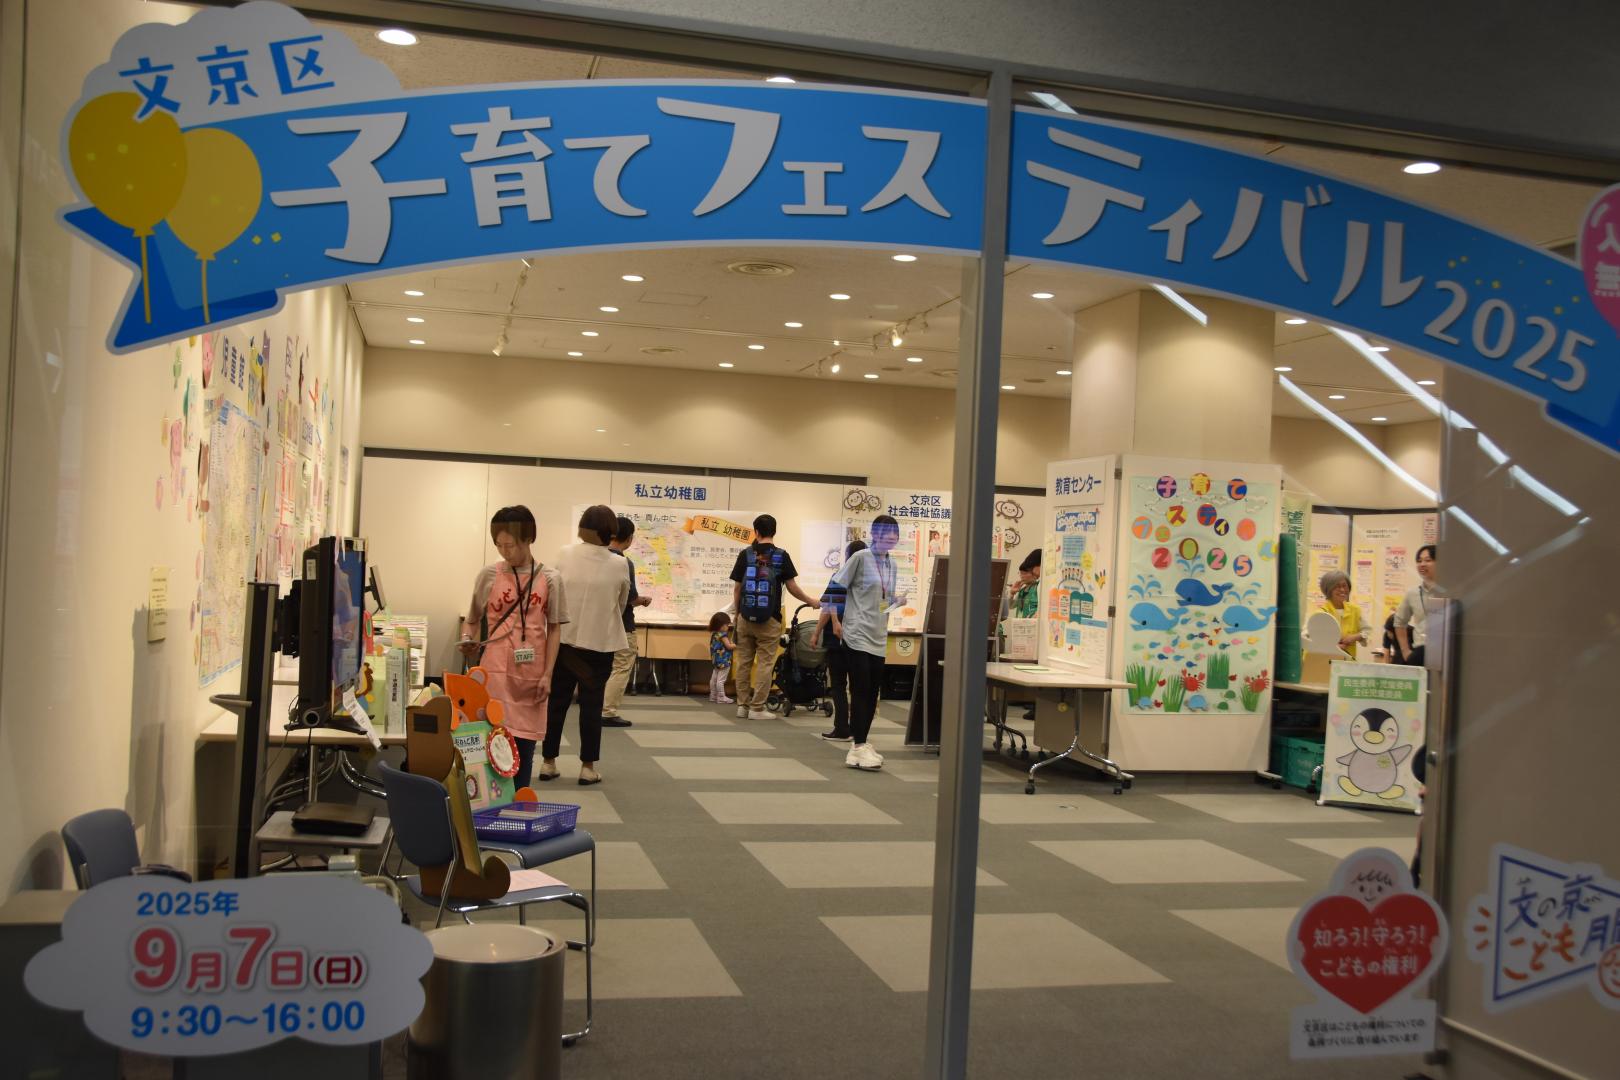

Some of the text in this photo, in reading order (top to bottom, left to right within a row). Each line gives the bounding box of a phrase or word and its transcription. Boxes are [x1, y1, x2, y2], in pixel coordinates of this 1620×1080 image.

[119, 35, 335, 119] 文京区
[634, 484, 707, 501] 私立幼稚園
[1055, 474, 1102, 496] 教育センター
[910, 495, 941, 506] 文京区
[1152, 538, 1252, 577] 2025
[515, 653, 533, 662] STAFF
[137, 891, 239, 917] 2025年
[1319, 954, 1418, 977] こどもの権利
